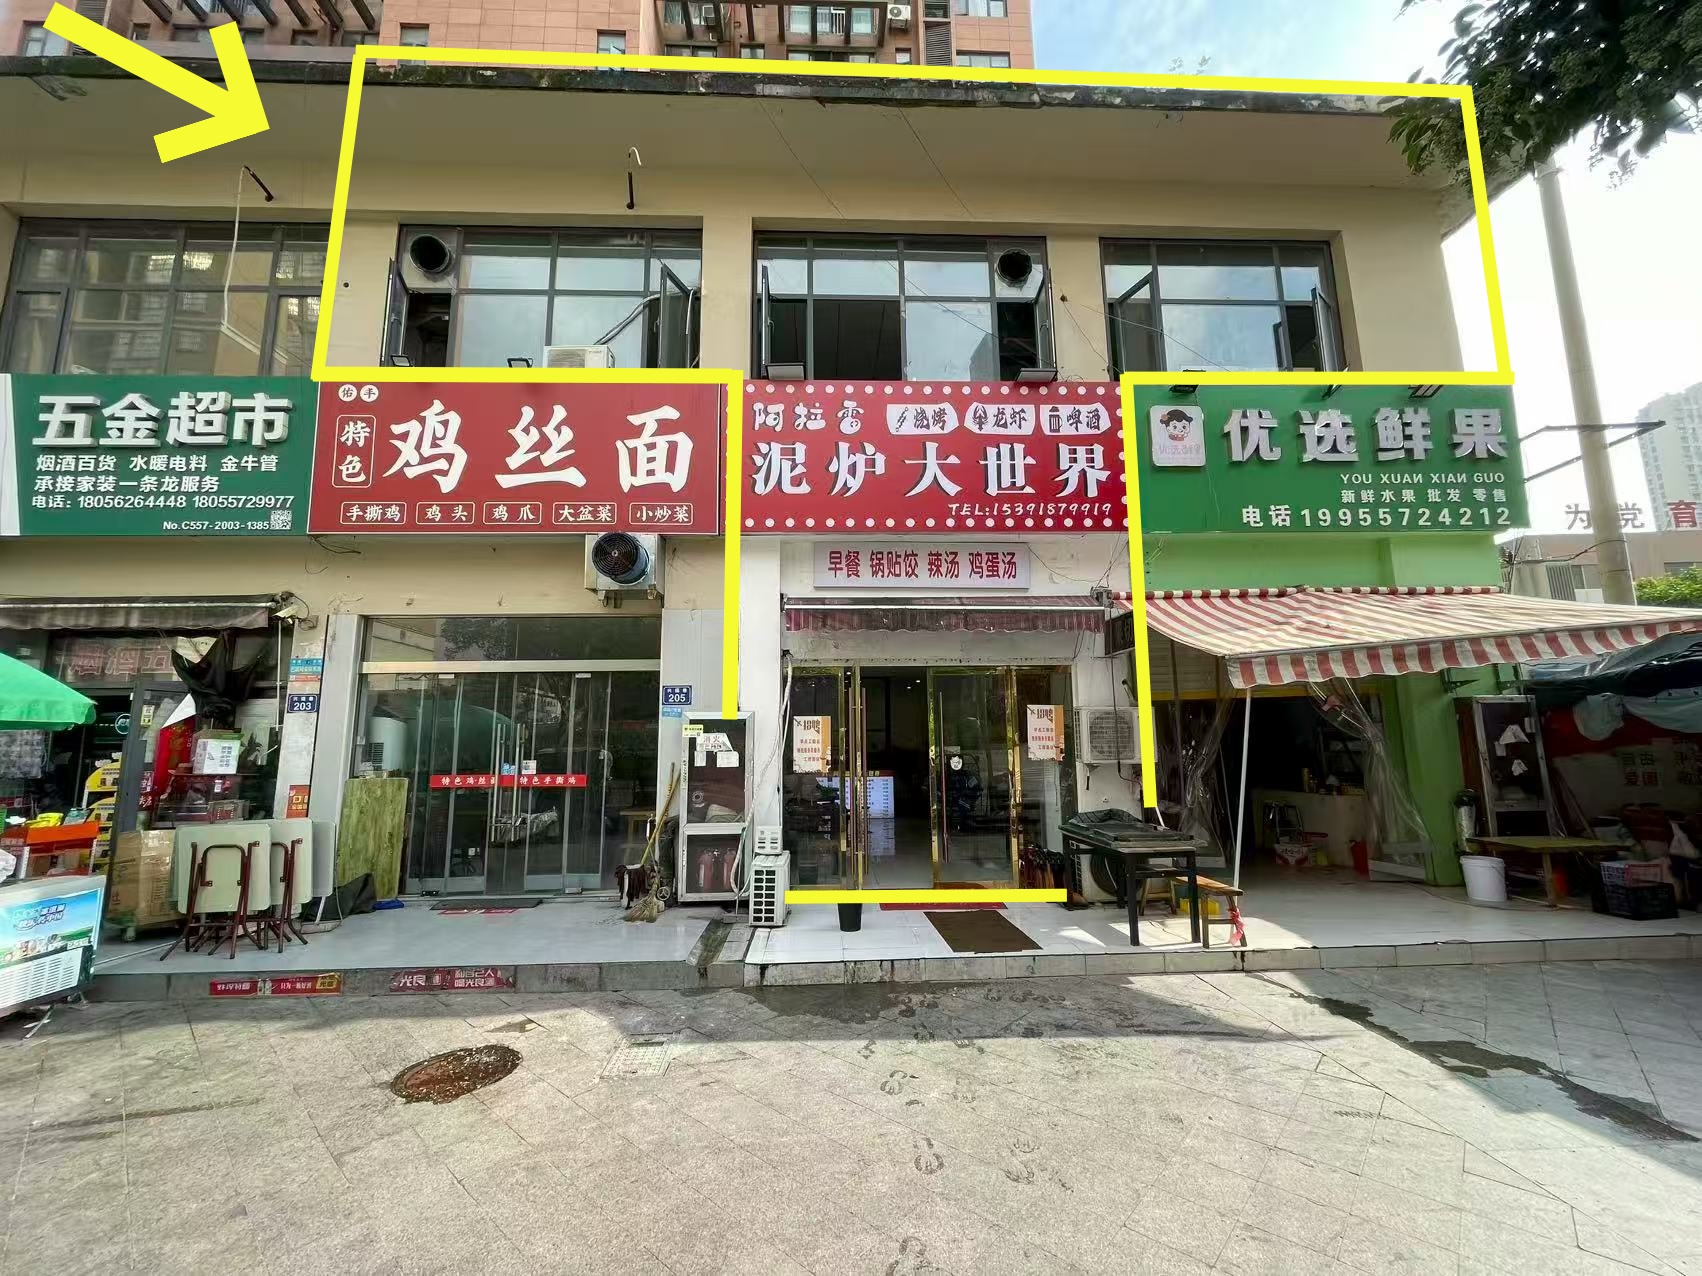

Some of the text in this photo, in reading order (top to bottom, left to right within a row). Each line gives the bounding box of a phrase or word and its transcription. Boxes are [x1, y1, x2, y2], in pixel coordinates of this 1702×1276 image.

[32, 392, 293, 448] 五金超市
[913, 406, 947, 431] 烧烤
[992, 407, 1028, 430] 龙虾
[1066, 406, 1101, 432] 啤酒
[1223, 407, 1508, 464] 优选鲜果
[338, 420, 371, 483] 特色
[382, 400, 694, 494] 鸡丝面
[36, 454, 279, 472] 烟酒百货 水暖电料 金牛管
[751, 441, 1112, 498] 泥炉大世界
[34, 475, 220, 492] 承接家装一条龙服务
[1340, 473, 1372, 484] YOU
[1473, 472, 1505, 483] GUO
[78, 495, 186, 508] 18056264448
[193, 495, 294, 508] 18055729977
[1341, 488, 1507, 503] 新鲜水果 批发 零售
[345, 505, 401, 522] 手撕鸡
[424, 505, 469, 522] 鸡头
[491, 505, 536, 522] 鸡爪
[557, 505, 613, 522] 大盆菜
[636, 506, 690, 522] 小炒菜
[948, 503, 1112, 516] TEL:15391879919
[1242, 505, 1511, 527] 电话 19955724212
[162, 521, 269, 530] No.C557-2003-1385
[827, 550, 1017, 579] 早餐 锅贴饺 辣汤 鸡蛋汤
[668, 693, 686, 702] 205
[293, 702, 312, 711] 203
[399, 974, 426, 987] 光良
